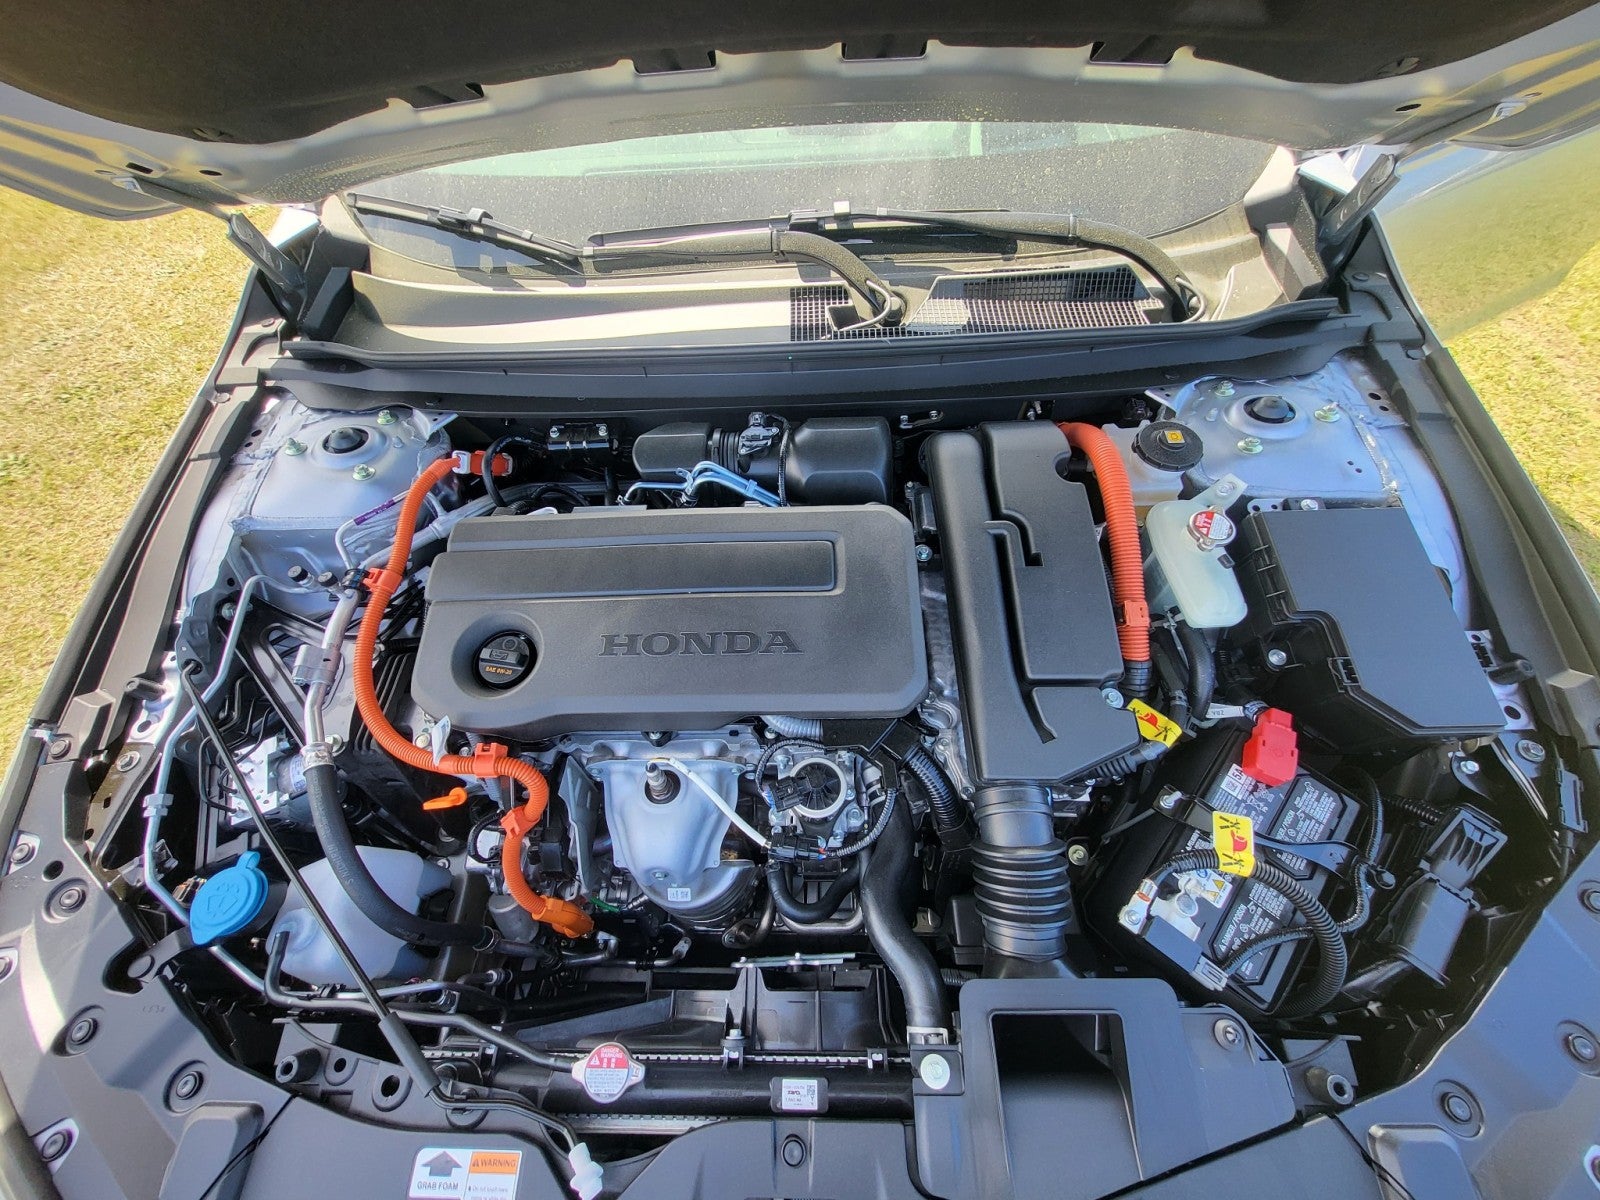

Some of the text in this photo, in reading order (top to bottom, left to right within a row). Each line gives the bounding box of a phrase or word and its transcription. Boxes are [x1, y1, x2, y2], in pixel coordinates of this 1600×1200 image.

[598, 629, 804, 657] HONDA
[480, 1159, 516, 1168] WARNING
[417, 1181, 437, 1191] GRAB
[438, 1181, 459, 1191] FOAM
